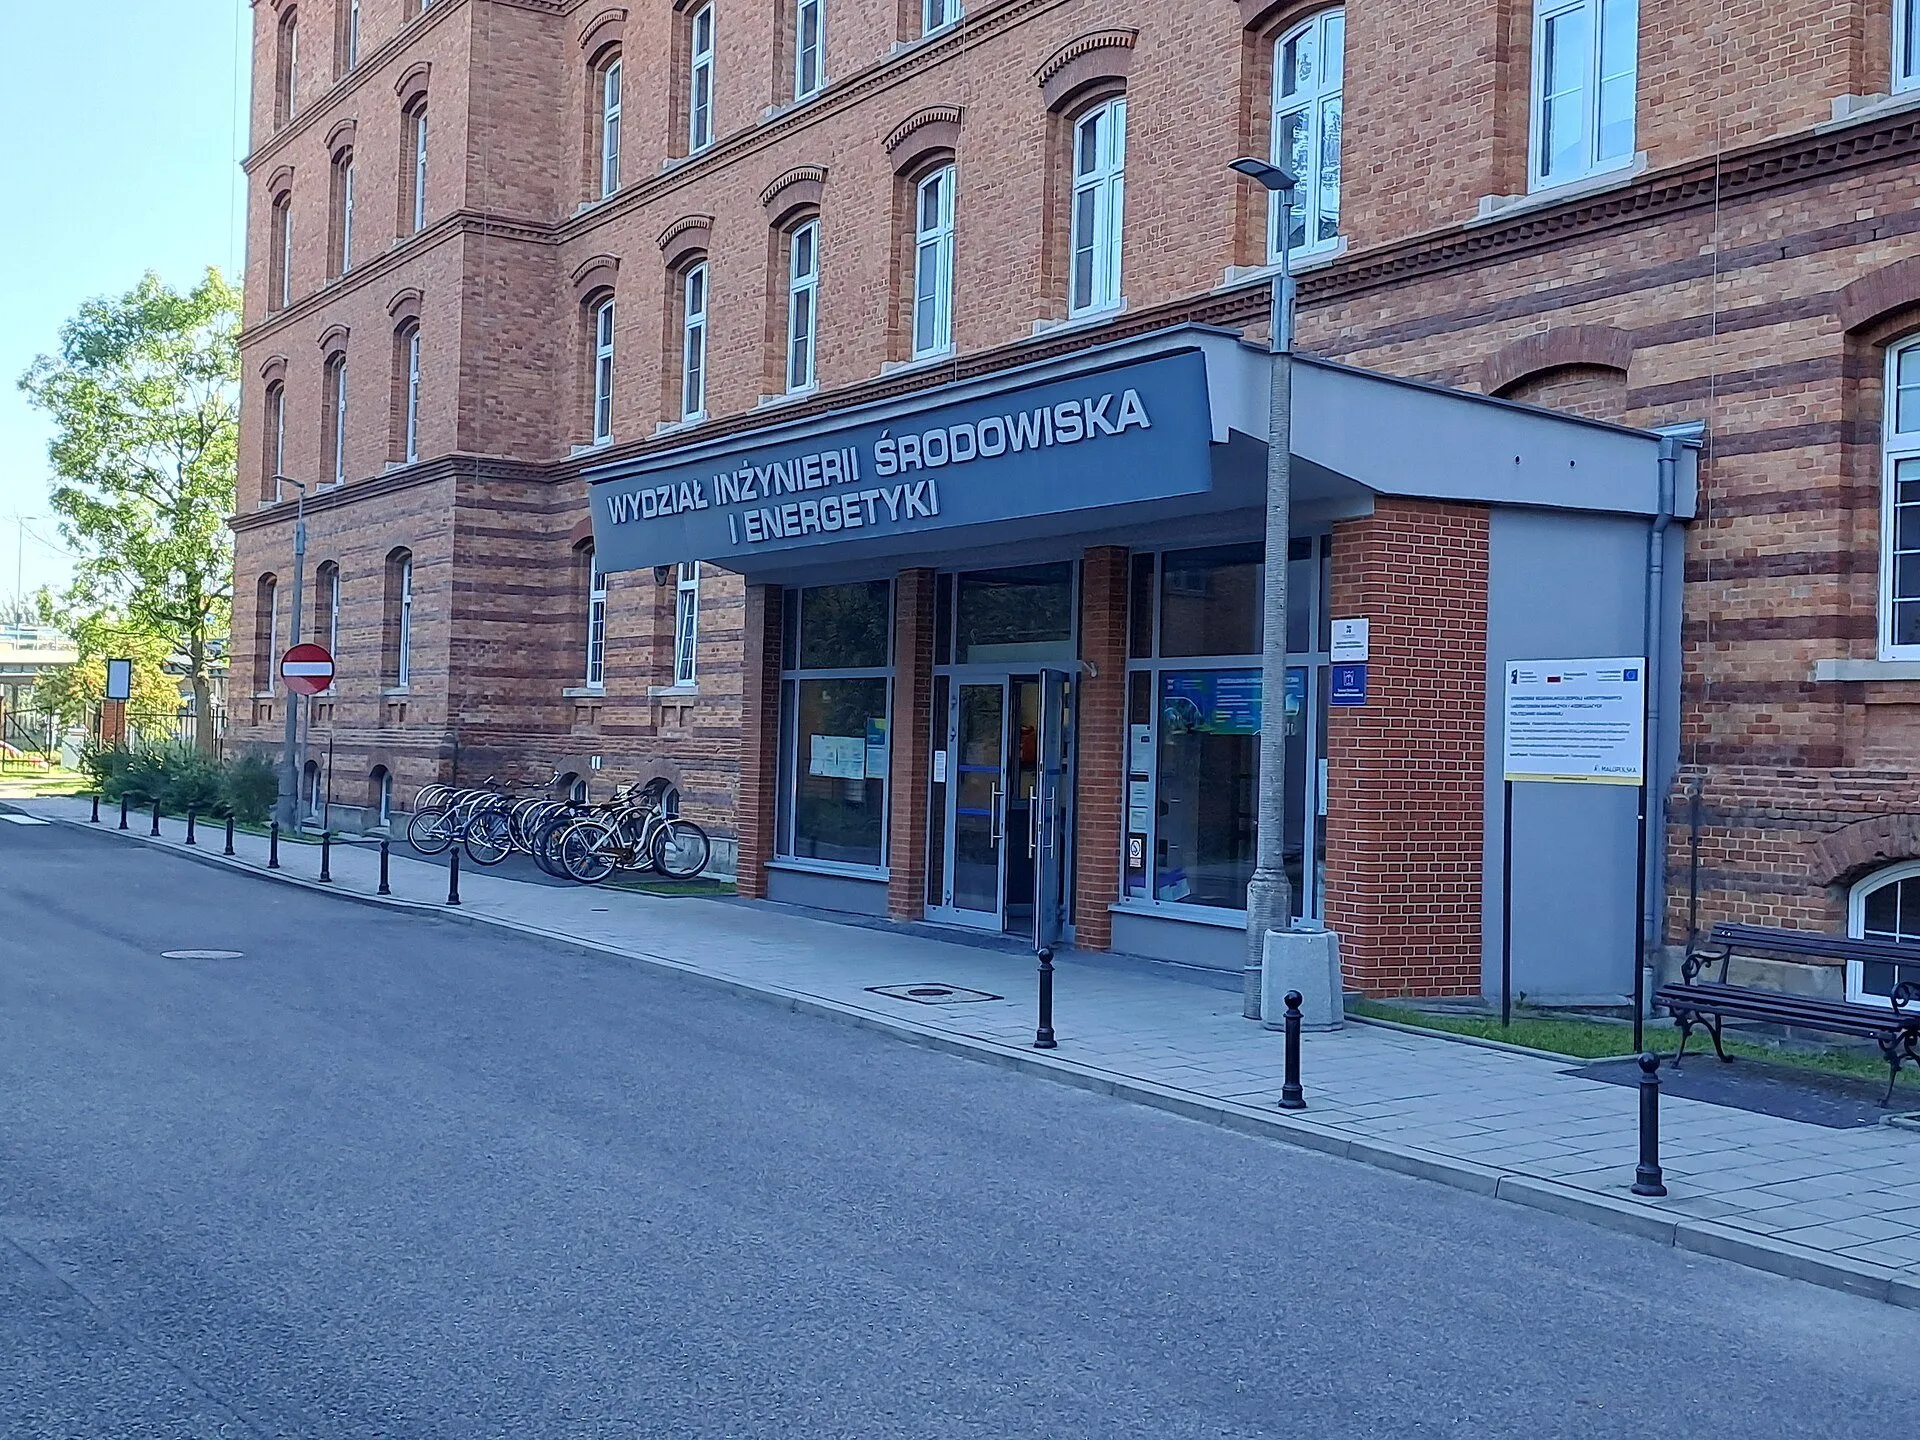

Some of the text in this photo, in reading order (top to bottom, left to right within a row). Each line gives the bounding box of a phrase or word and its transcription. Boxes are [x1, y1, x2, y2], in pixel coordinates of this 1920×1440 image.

[607, 389, 1152, 525] WYDZIAŁ INŻYNIERII ŚRODOWISKA
[728, 479, 940, 545] I ENERGETYKI
